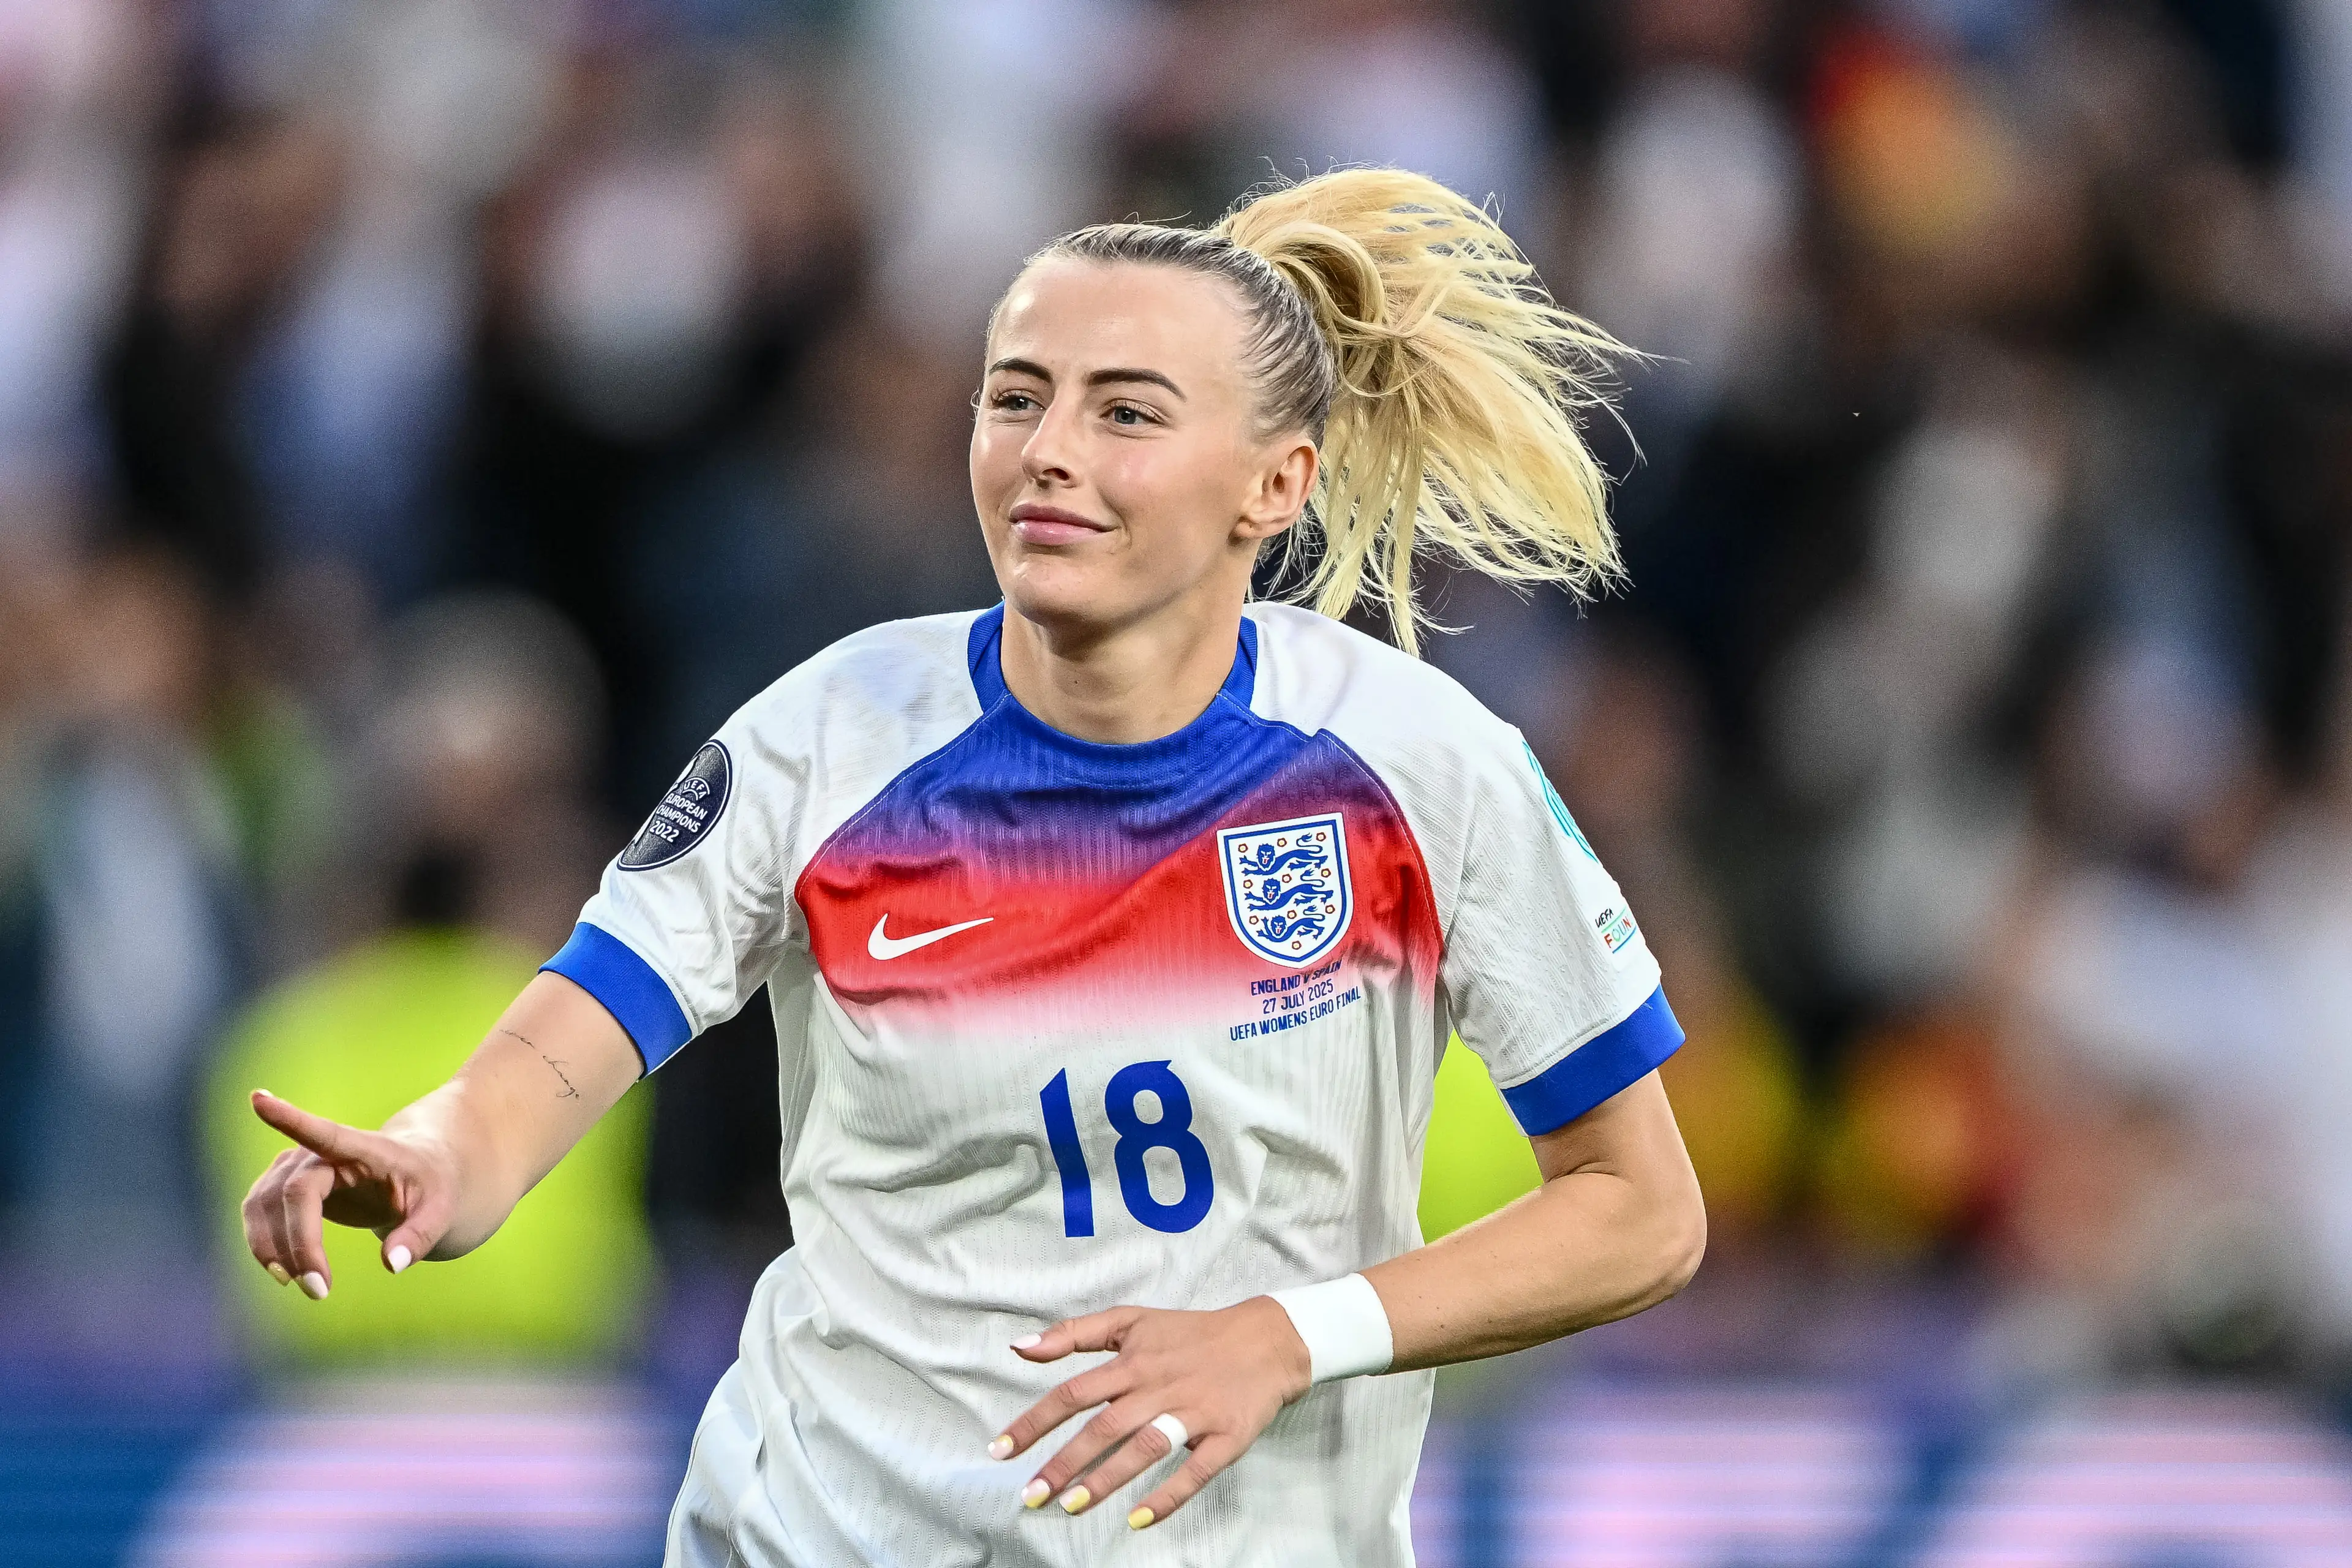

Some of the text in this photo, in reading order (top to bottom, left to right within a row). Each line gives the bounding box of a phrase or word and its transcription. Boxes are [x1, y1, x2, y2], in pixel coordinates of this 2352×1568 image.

[684, 780, 707, 799] UEFA
[656, 804, 701, 832] CHAMPIONS
[665, 793, 707, 820] EUROPEAN
[649, 820, 679, 842] 2022
[1595, 908, 1613, 928] UEFA
[1604, 914, 1634, 948] FOUN
[1251, 974, 1300, 996] ENGLAND
[1312, 960, 1342, 980] SPAIN
[1262, 979, 1333, 1014] 27 JULY 2025
[1230, 986, 1361, 1041] UEFA WOMENS EURO FINAL
[1039, 1059, 1215, 1238] 18
